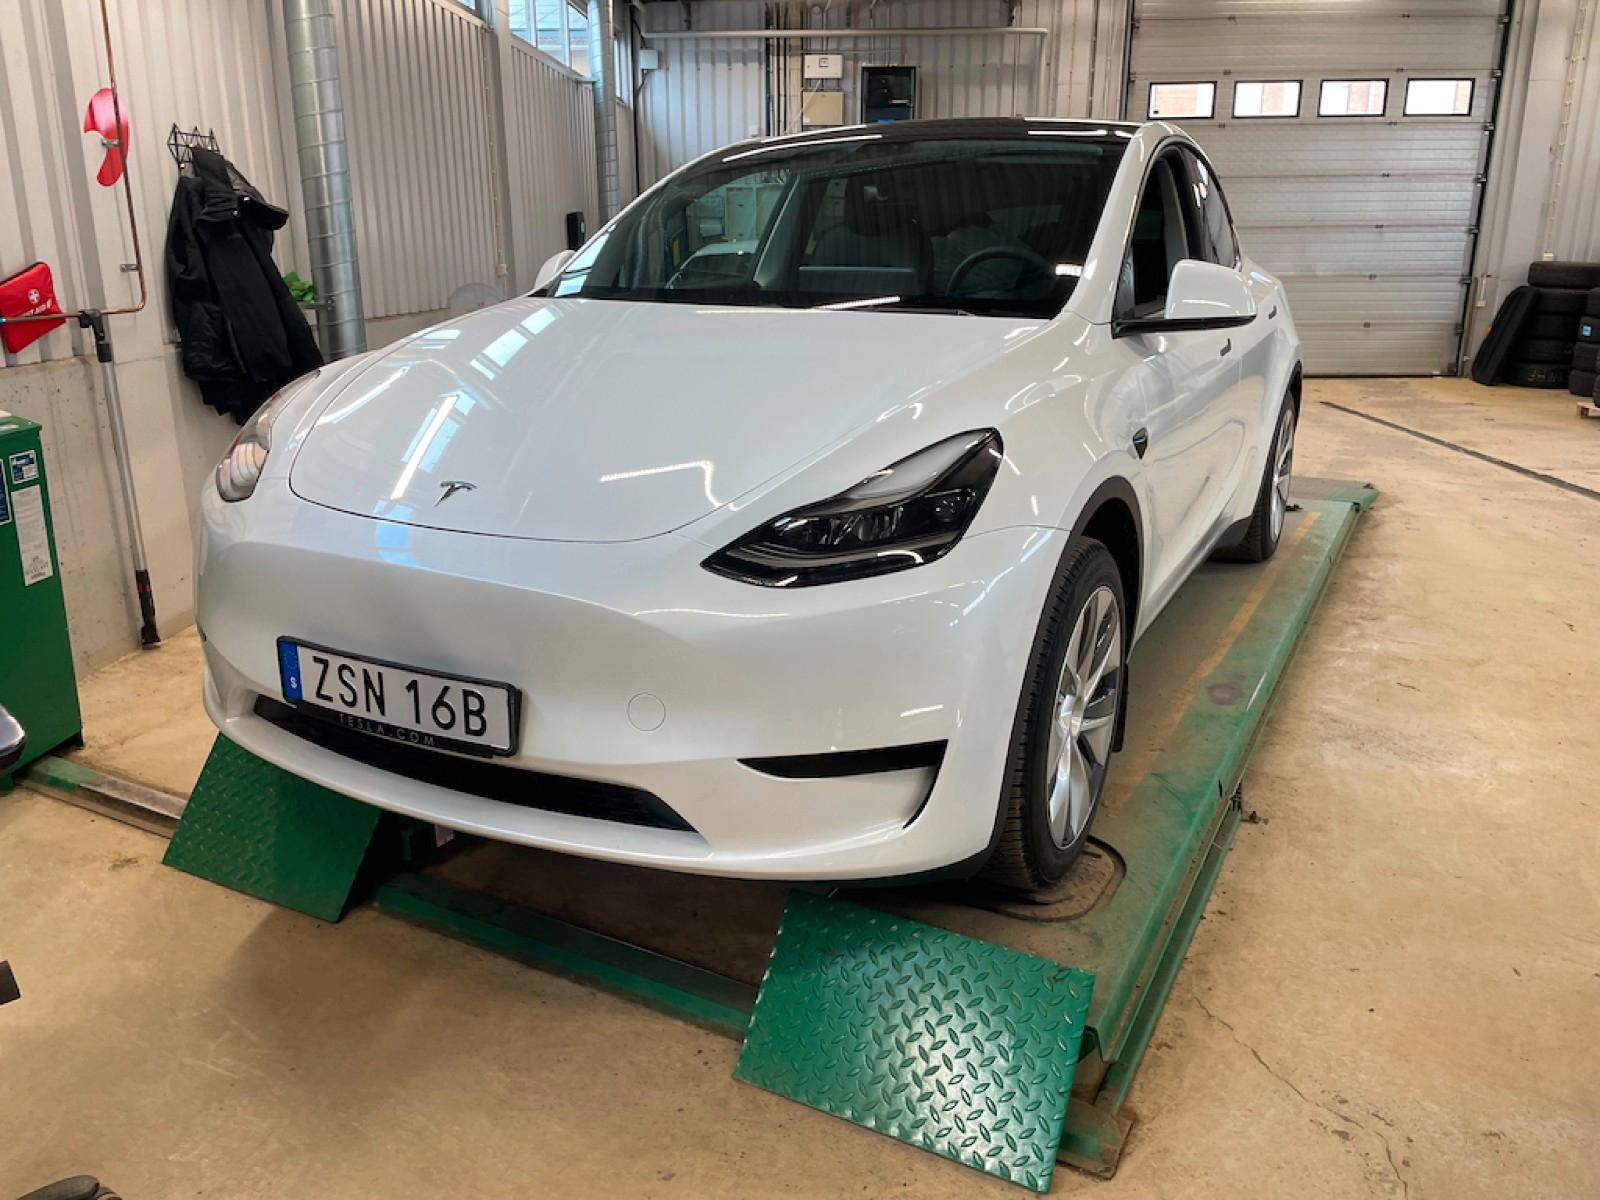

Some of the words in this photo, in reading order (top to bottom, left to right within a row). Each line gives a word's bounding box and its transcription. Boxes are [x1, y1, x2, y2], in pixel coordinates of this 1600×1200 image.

[290, 676, 297, 689] S
[312, 655, 386, 717] ZSN
[405, 679, 487, 737] 16B
[339, 713, 435, 746] TESLA.COM
